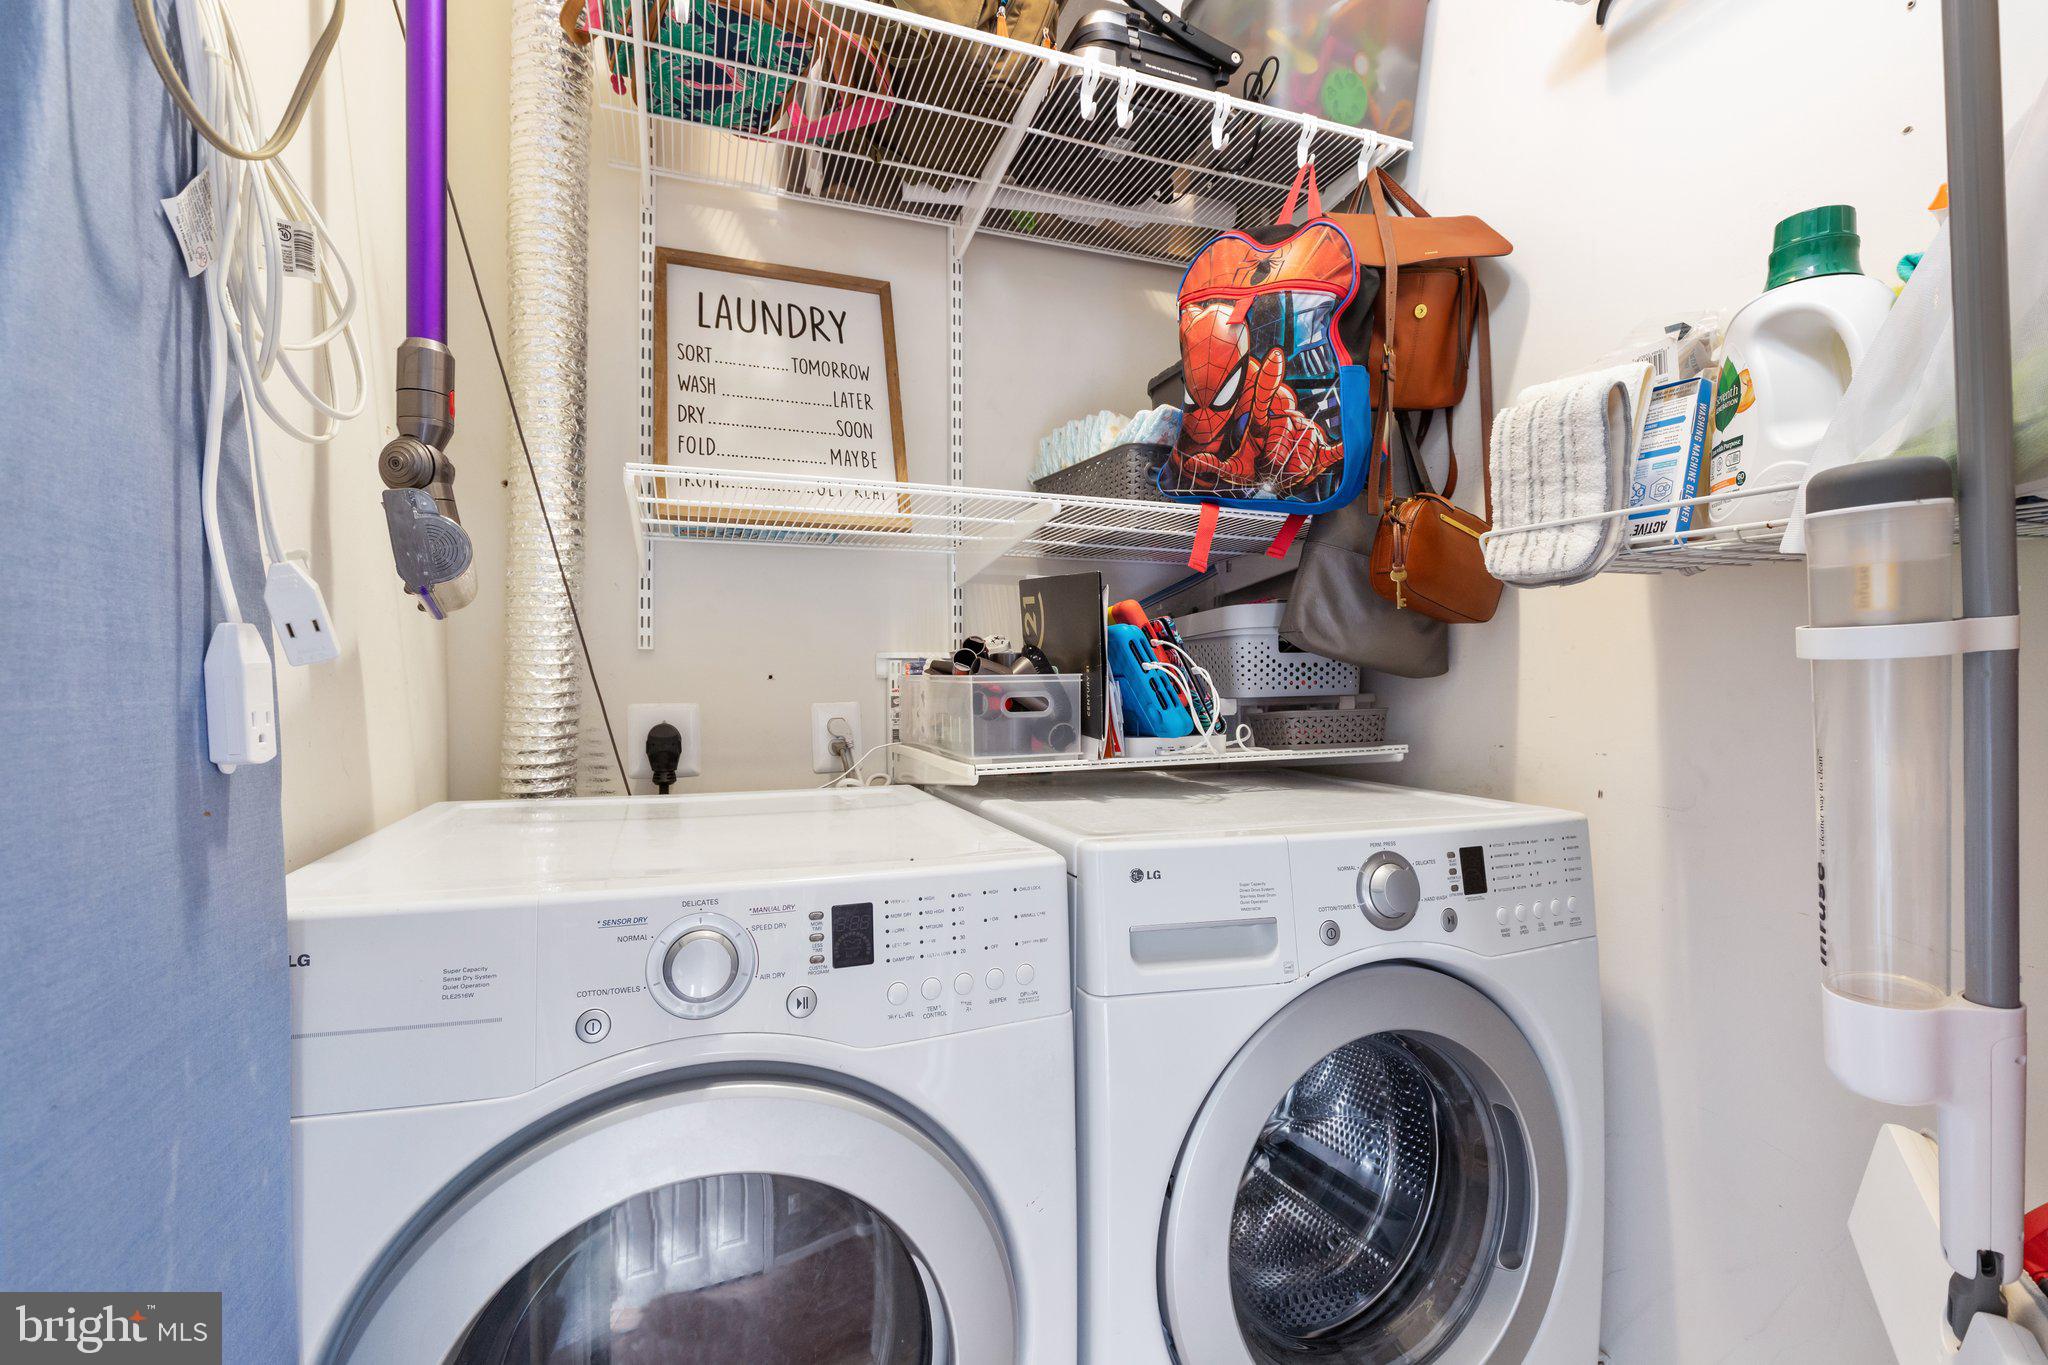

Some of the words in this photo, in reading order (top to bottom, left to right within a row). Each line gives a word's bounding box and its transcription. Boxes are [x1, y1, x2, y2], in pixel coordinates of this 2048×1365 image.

[698, 291, 846, 344] LAUNDRY
[677, 343, 712, 364] SORT
[791, 357, 870, 382] TOMORROW
[677, 374, 716, 395] WASH
[833, 390, 874, 410] LATER
[677, 404, 705, 424] DRY
[837, 420, 873, 440] SOON
[1694, 403, 1707, 441] WASHING
[678, 435, 716, 456] FOLD
[830, 448, 878, 470] MAYBE
[1688, 443, 1702, 484] MACHINE
[1147, 870, 1161, 880] LG
[682, 899, 718, 908] DELICATES
[752, 905, 781, 913] MANUAL
[602, 917, 632, 926] SENSOR
[633, 916, 648, 924] DRY
[751, 923, 772, 931] SPEED
[774, 922, 788, 930] DRY
[617, 934, 648, 942] NORMAL
[289, 954, 310, 967] LG
[577, 985, 641, 997] COTTON/TOWELS
